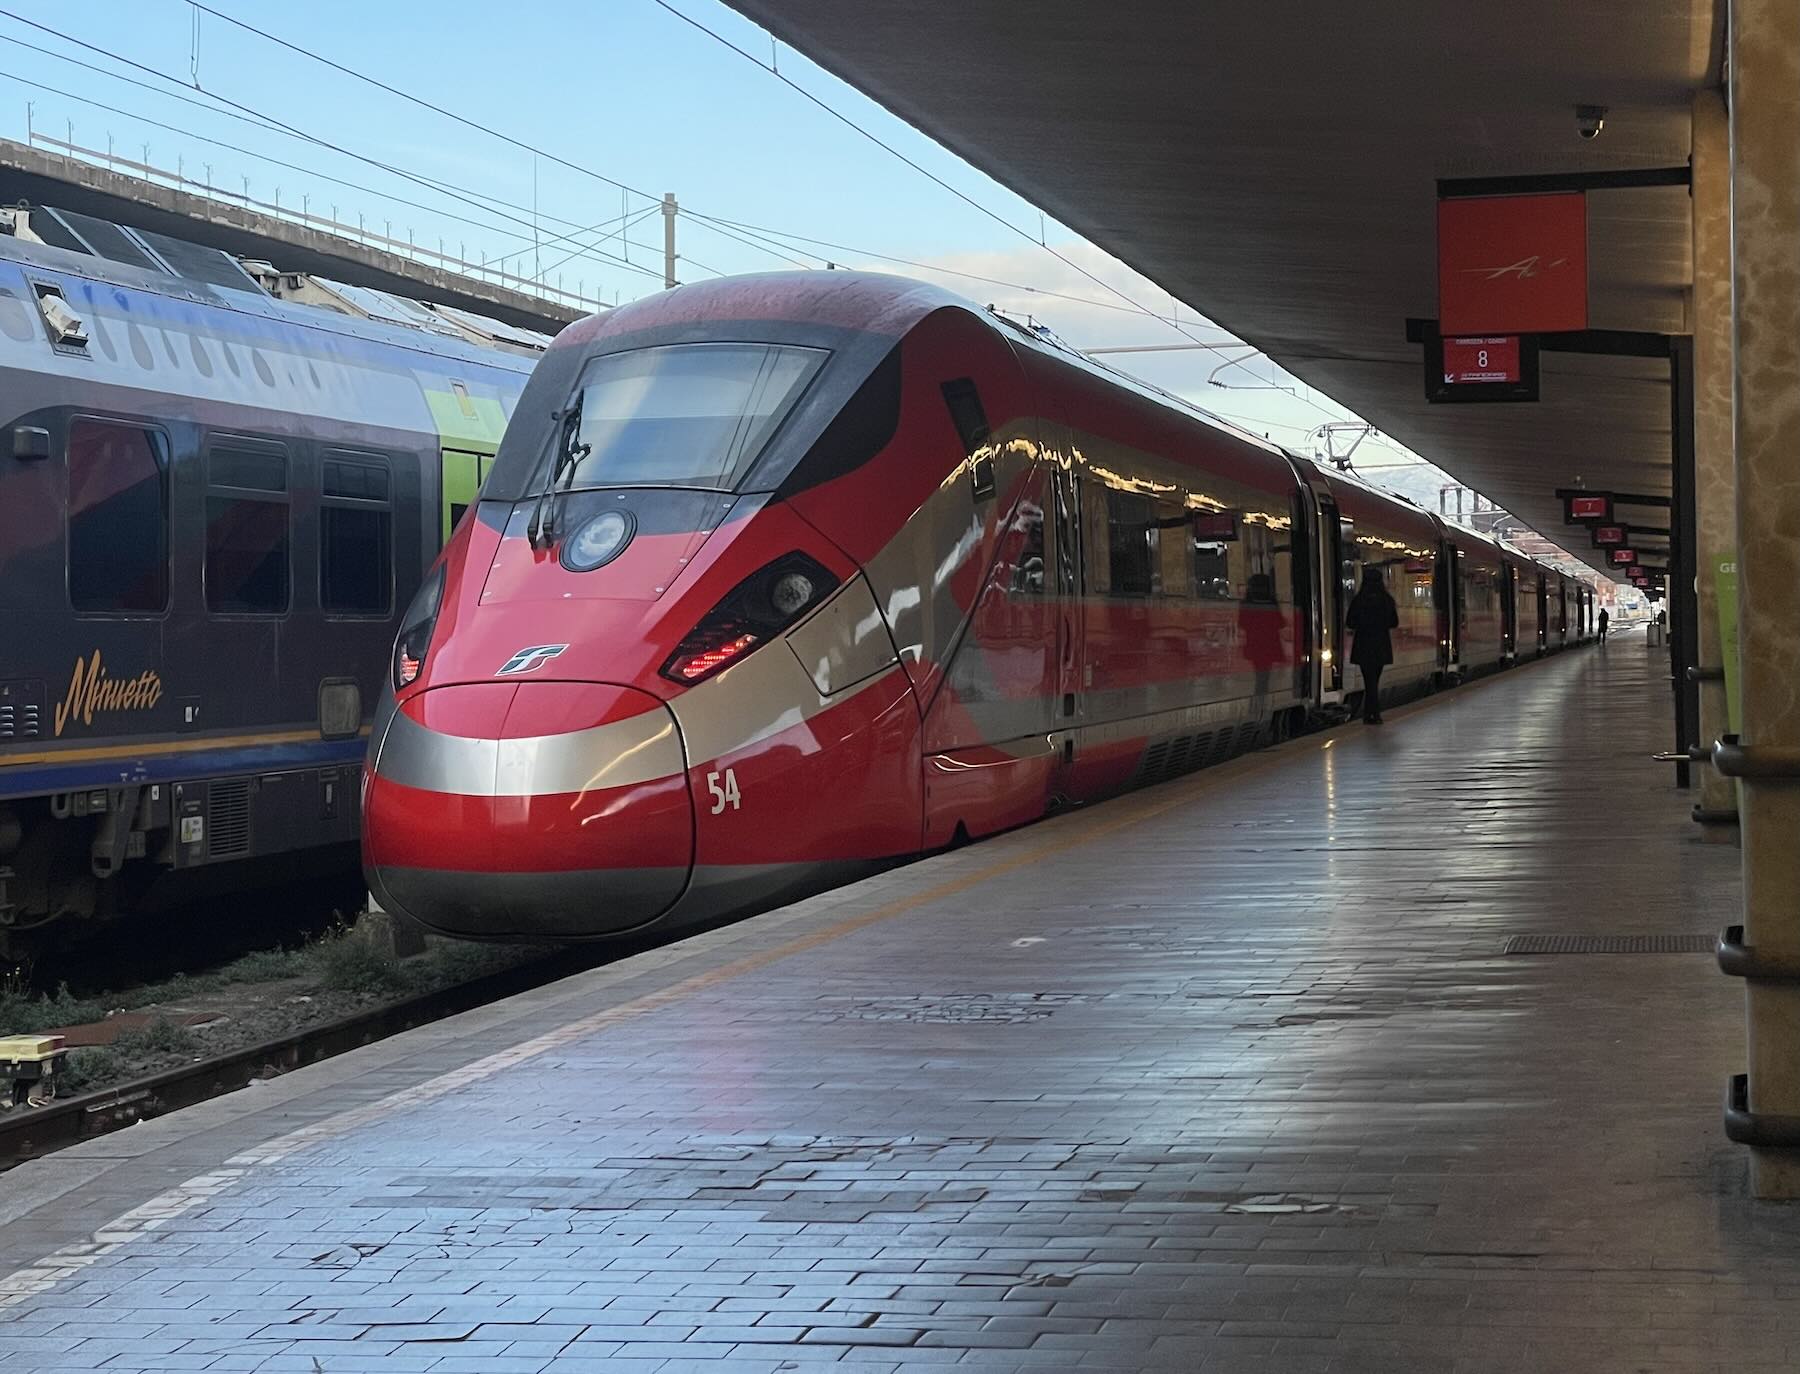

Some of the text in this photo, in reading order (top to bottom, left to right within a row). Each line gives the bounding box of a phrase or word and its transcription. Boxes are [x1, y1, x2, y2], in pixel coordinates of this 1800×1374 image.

[1478, 350, 1488, 368] 8
[54, 648, 163, 737] Minuetto
[707, 768, 742, 815] 54
